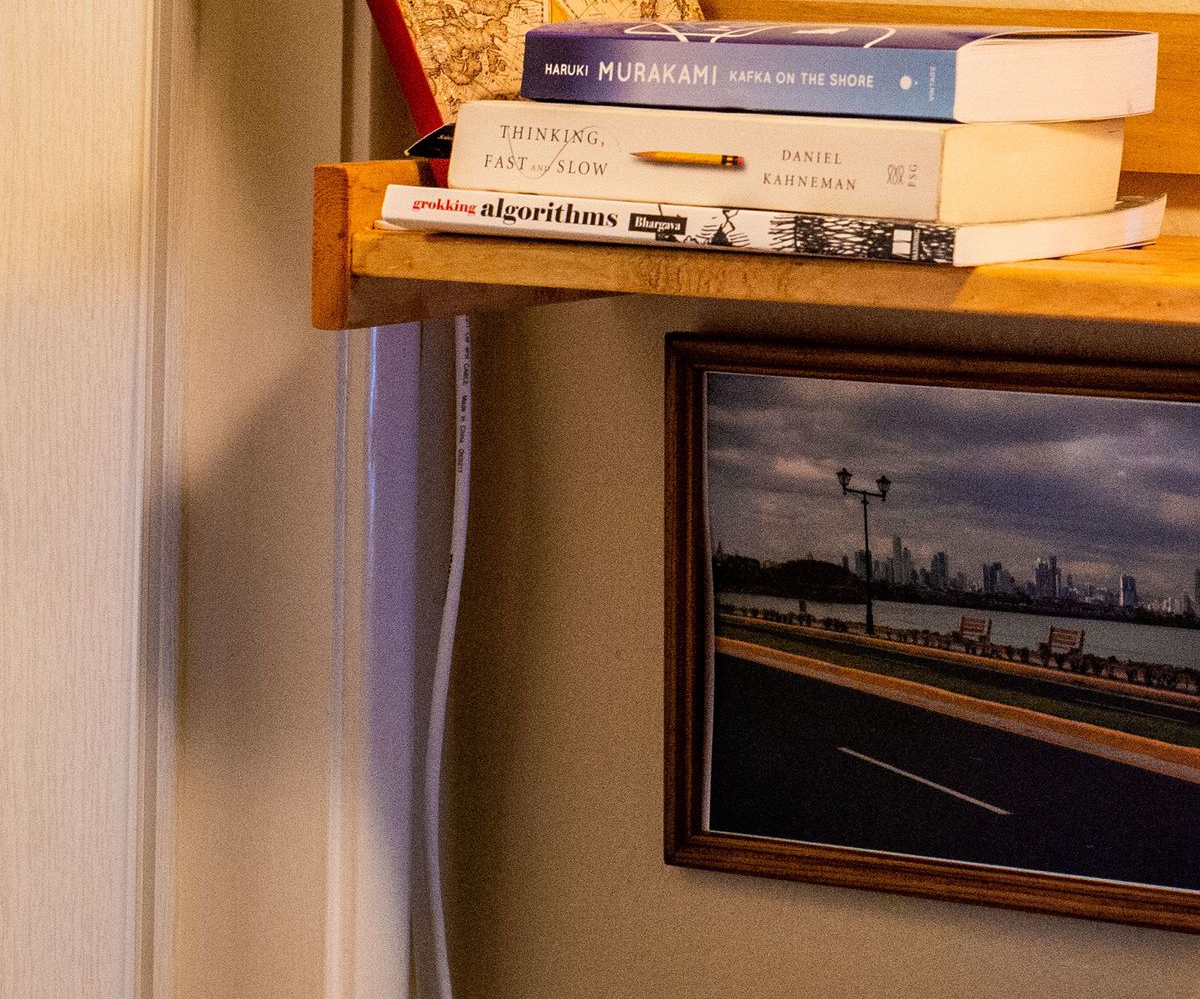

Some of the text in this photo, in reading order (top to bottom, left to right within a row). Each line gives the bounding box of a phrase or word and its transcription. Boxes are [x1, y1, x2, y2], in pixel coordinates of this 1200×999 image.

[544, 61, 717, 86] HARUKI MURAKAMI
[729, 70, 875, 88] KAFKA ON THE SHORE
[500, 125, 606, 147] THINKING,
[484, 154, 608, 176] FAST AND SLOW
[781, 149, 843, 165] DANIEL
[762, 172, 857, 191] KAHNEMAN
[412, 198, 619, 228] grokking algorithms
[634, 215, 681, 233] Bhargava
